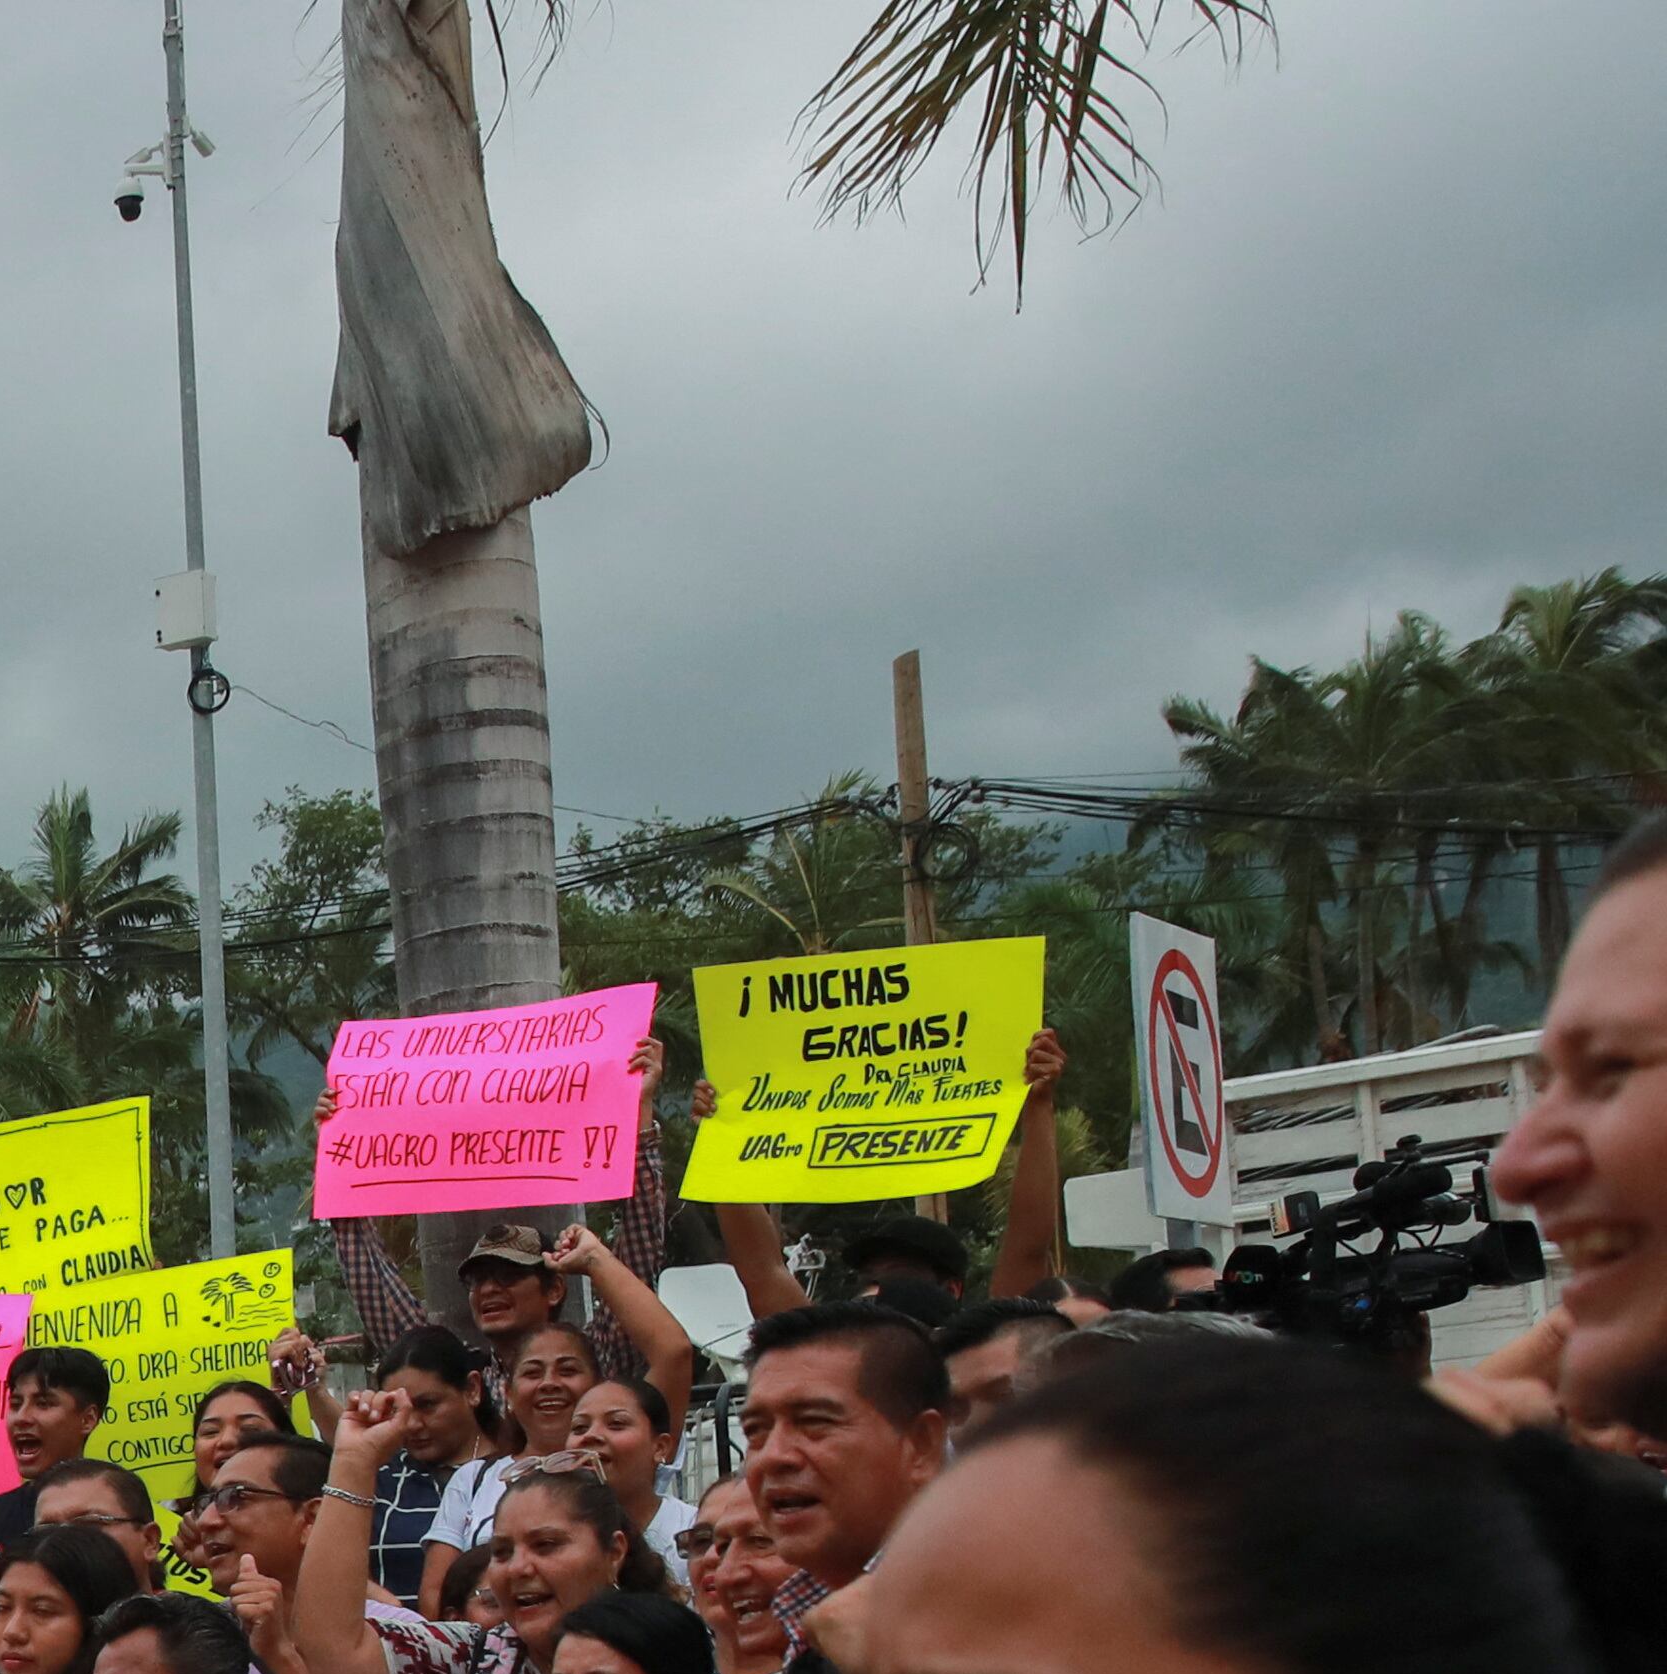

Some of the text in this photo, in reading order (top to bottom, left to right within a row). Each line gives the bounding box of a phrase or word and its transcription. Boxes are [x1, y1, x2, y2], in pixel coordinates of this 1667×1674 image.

[769, 963, 909, 1013] MUCHAS
[342, 1004, 607, 1058] LAS UNIVERSITARIAS
[802, 1011, 967, 1062] GRACIAS!
[334, 1062, 589, 1109] ESTÁN CON CLAUDIA
[898, 1056, 966, 1078] CLAUDIA
[742, 1073, 811, 1112] UNIDOS
[933, 1076, 1001, 1104] FUERTES
[325, 1129, 565, 1168] #UAGRO PRESENTE
[739, 1125, 972, 1162] UAGro PRESENTE
[23, 1245, 145, 1296] CON CLAUDIA
[25, 1293, 178, 1347] IENVENIDA A
[128, 1392, 168, 1423] ESTÁ
